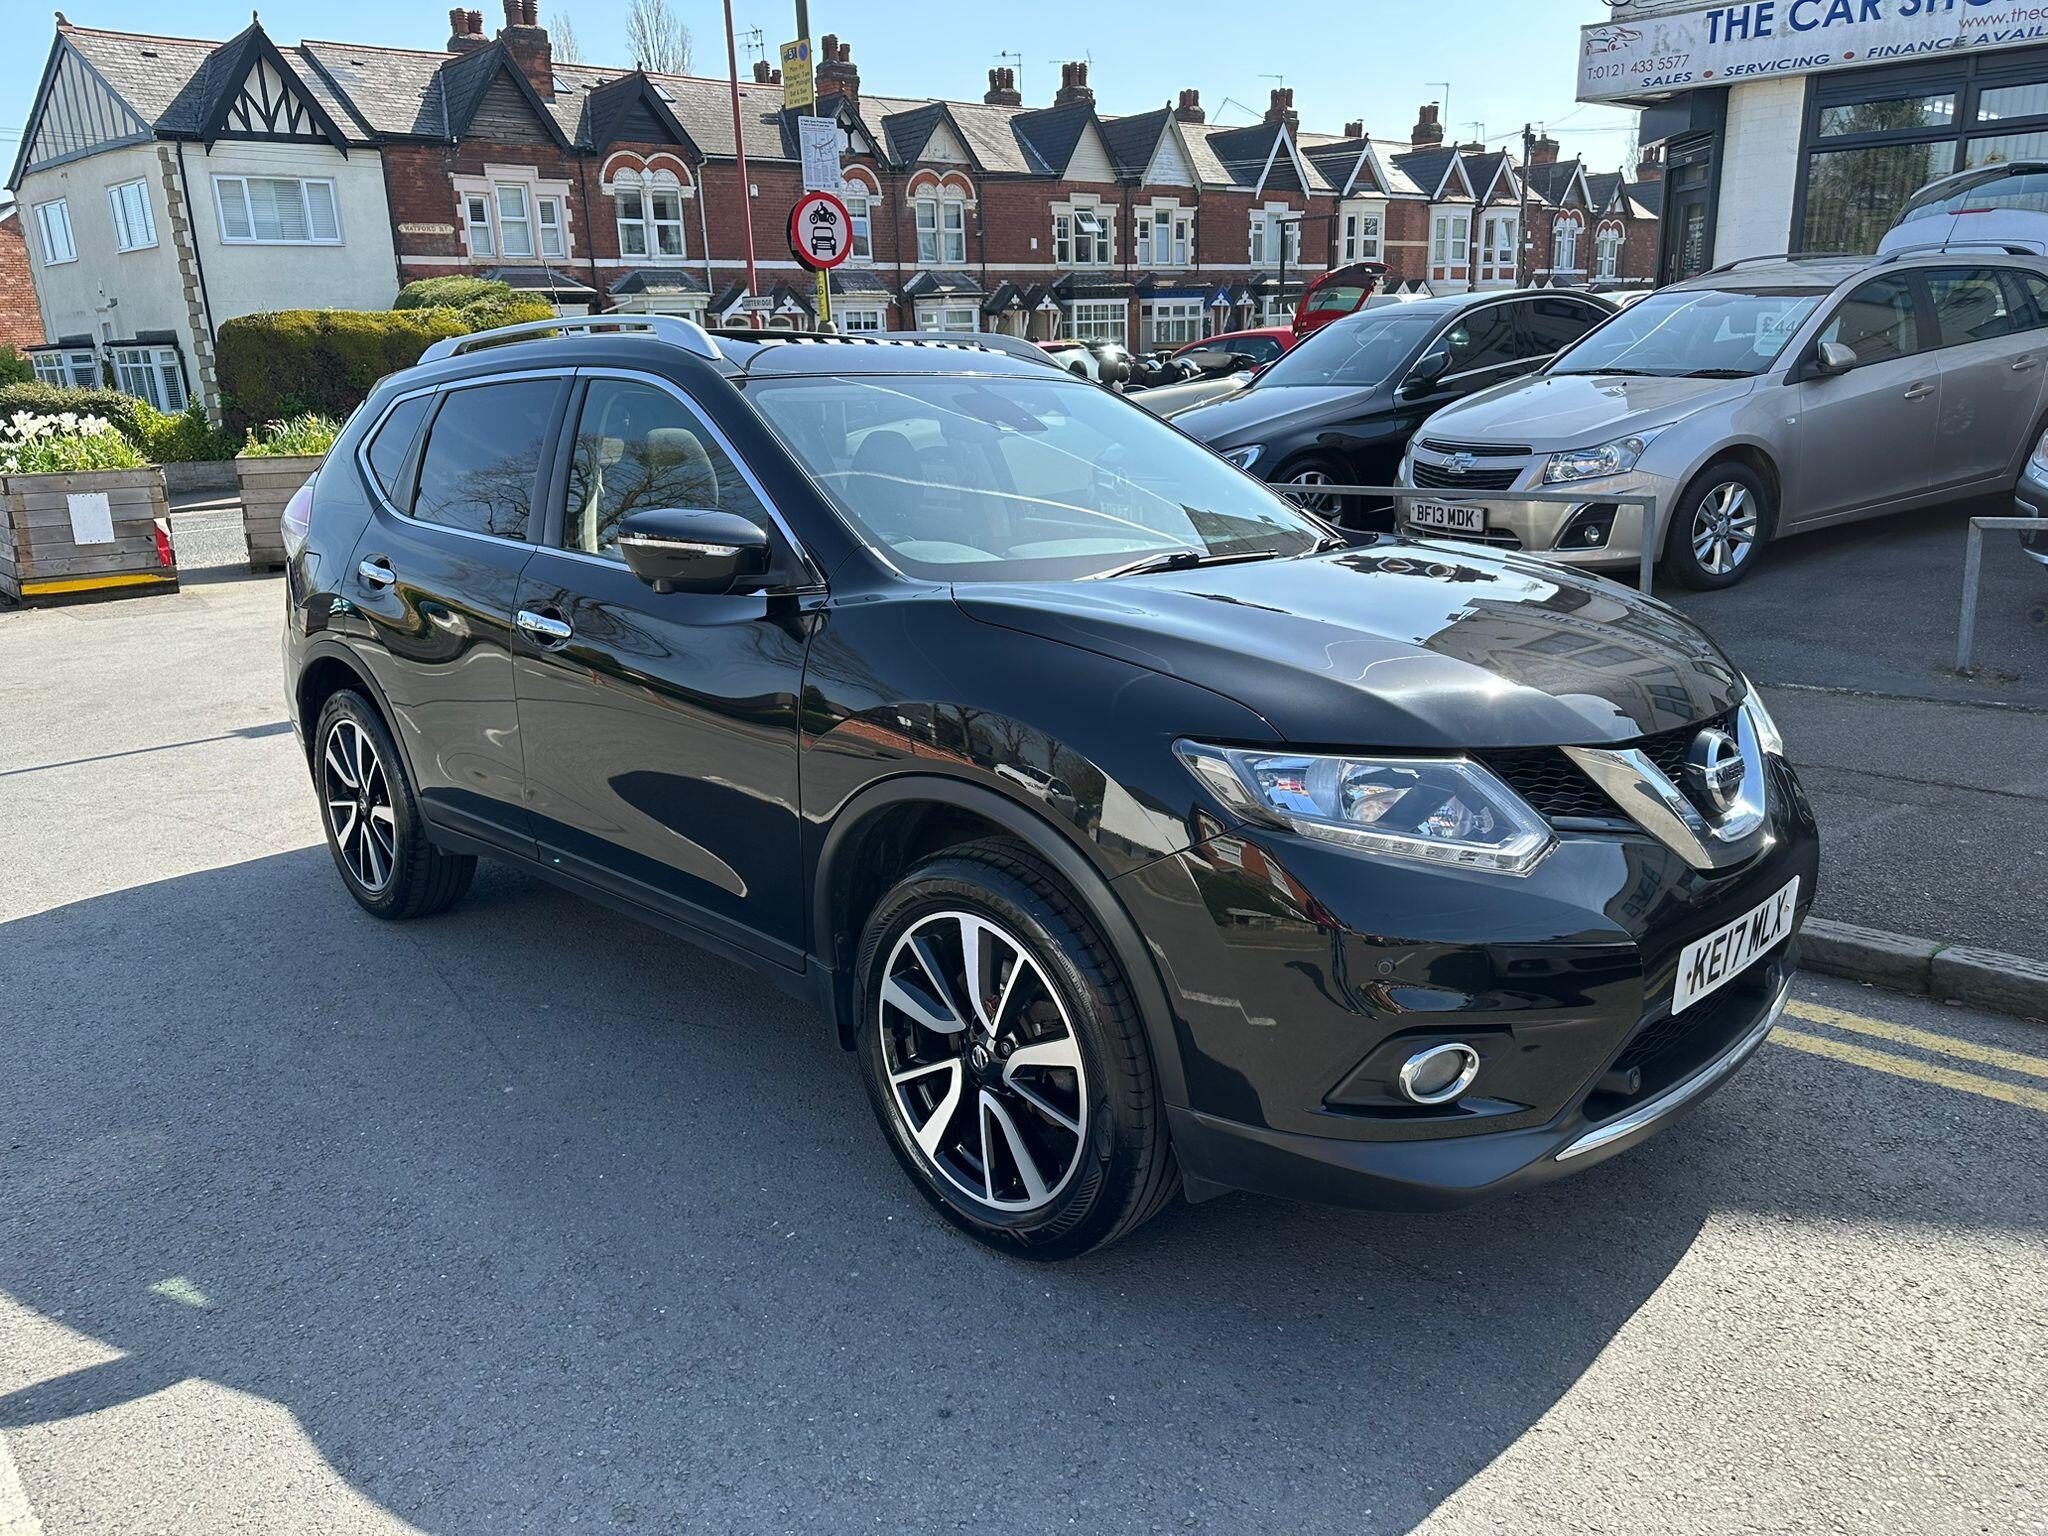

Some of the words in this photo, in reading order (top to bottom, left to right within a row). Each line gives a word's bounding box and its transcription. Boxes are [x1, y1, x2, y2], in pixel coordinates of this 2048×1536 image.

[1706, 1, 1775, 44] THE
[1788, 0, 1882, 32] CAR
[1630, 59, 1654, 74] 433
[1658, 54, 1690, 71] 5577
[1641, 71, 1693, 88] SALES
[1724, 54, 1831, 77] SERVICING
[1866, 35, 1968, 59] FINANCE
[1973, 25, 2048, 45] AVAIL
[1416, 504, 1444, 524] BF13
[1447, 507, 1475, 528] MDK
[1690, 920, 1748, 996] KE17
[1746, 890, 1787, 958] MLX
